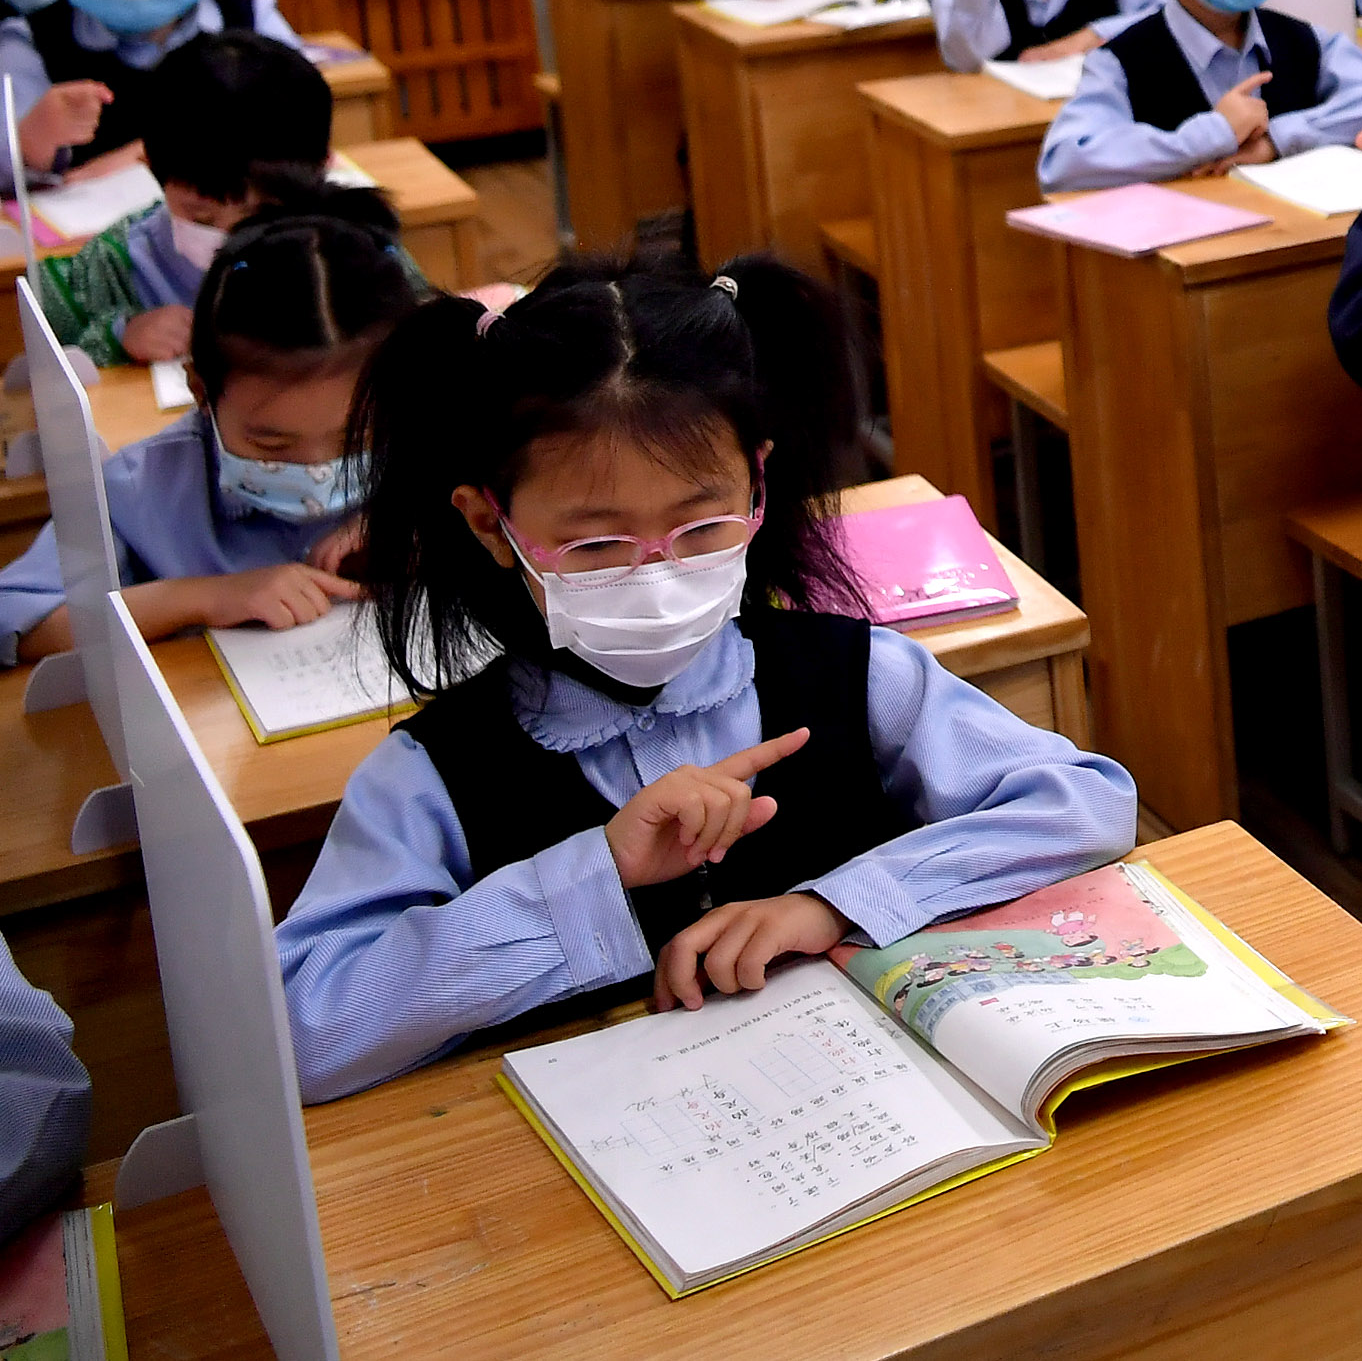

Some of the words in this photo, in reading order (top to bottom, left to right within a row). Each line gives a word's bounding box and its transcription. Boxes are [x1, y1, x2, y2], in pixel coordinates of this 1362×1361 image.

[830, 1018, 853, 1030] 体
[842, 1028, 863, 1039] 声
[851, 1038, 874, 1049] 跑
[863, 1047, 886, 1058] 打
[709, 1088, 729, 1099] 身
[718, 1098, 741, 1110] 足
[728, 1107, 753, 1120] 拍
